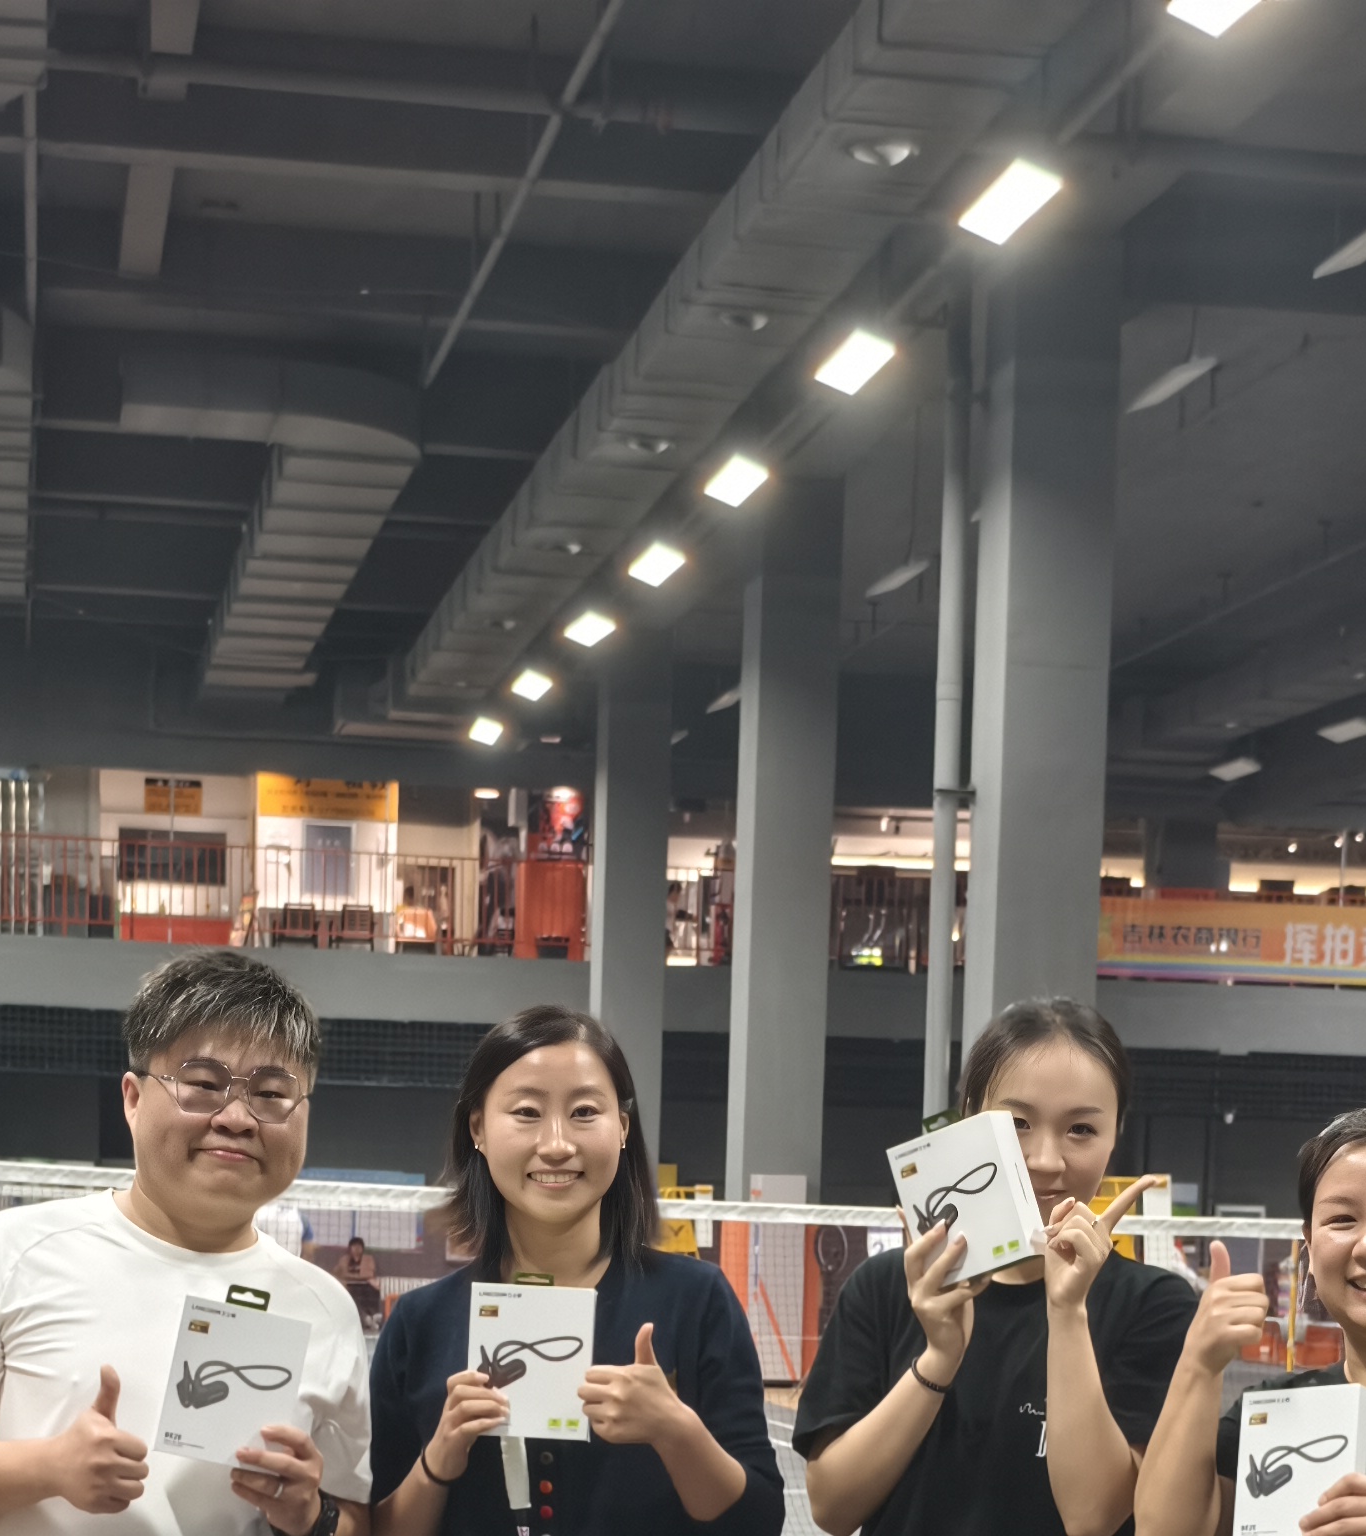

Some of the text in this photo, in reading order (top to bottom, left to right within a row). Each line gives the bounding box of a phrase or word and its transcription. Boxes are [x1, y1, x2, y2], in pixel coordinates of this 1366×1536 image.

[1123, 923, 1262, 950] 吉林农商银行
